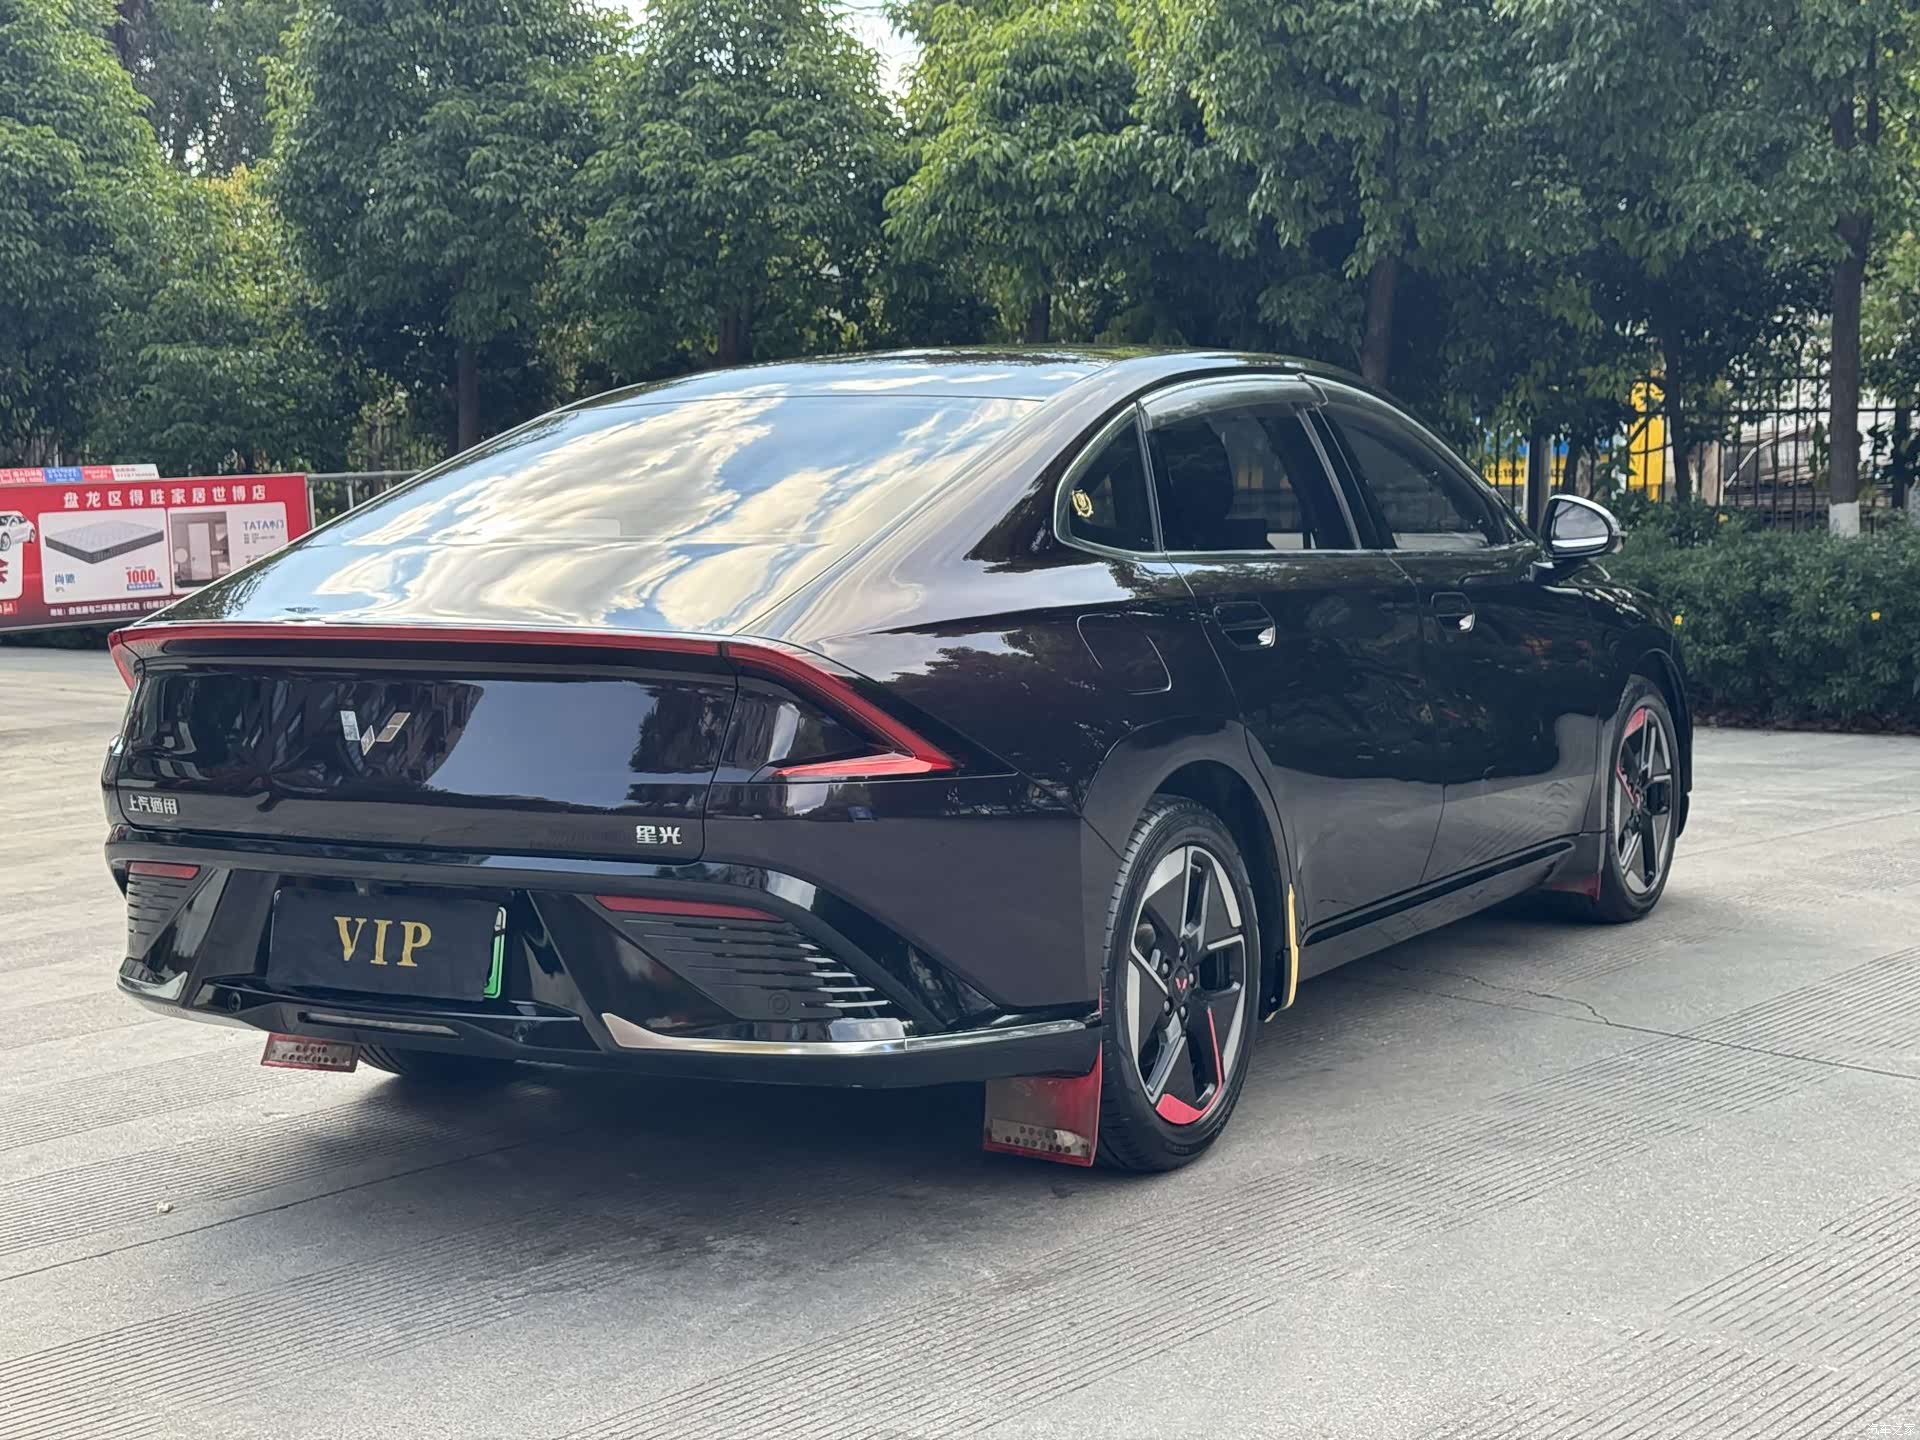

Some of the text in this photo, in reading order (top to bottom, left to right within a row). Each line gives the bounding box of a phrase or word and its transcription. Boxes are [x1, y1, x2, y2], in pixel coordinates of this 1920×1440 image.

[64, 485, 266, 509] 盘龙区得胜家居世博店
[127, 569, 156, 584] 1000
[129, 794, 178, 815] 上汽通用
[636, 825, 683, 845] 星光
[334, 916, 432, 967] VIP
